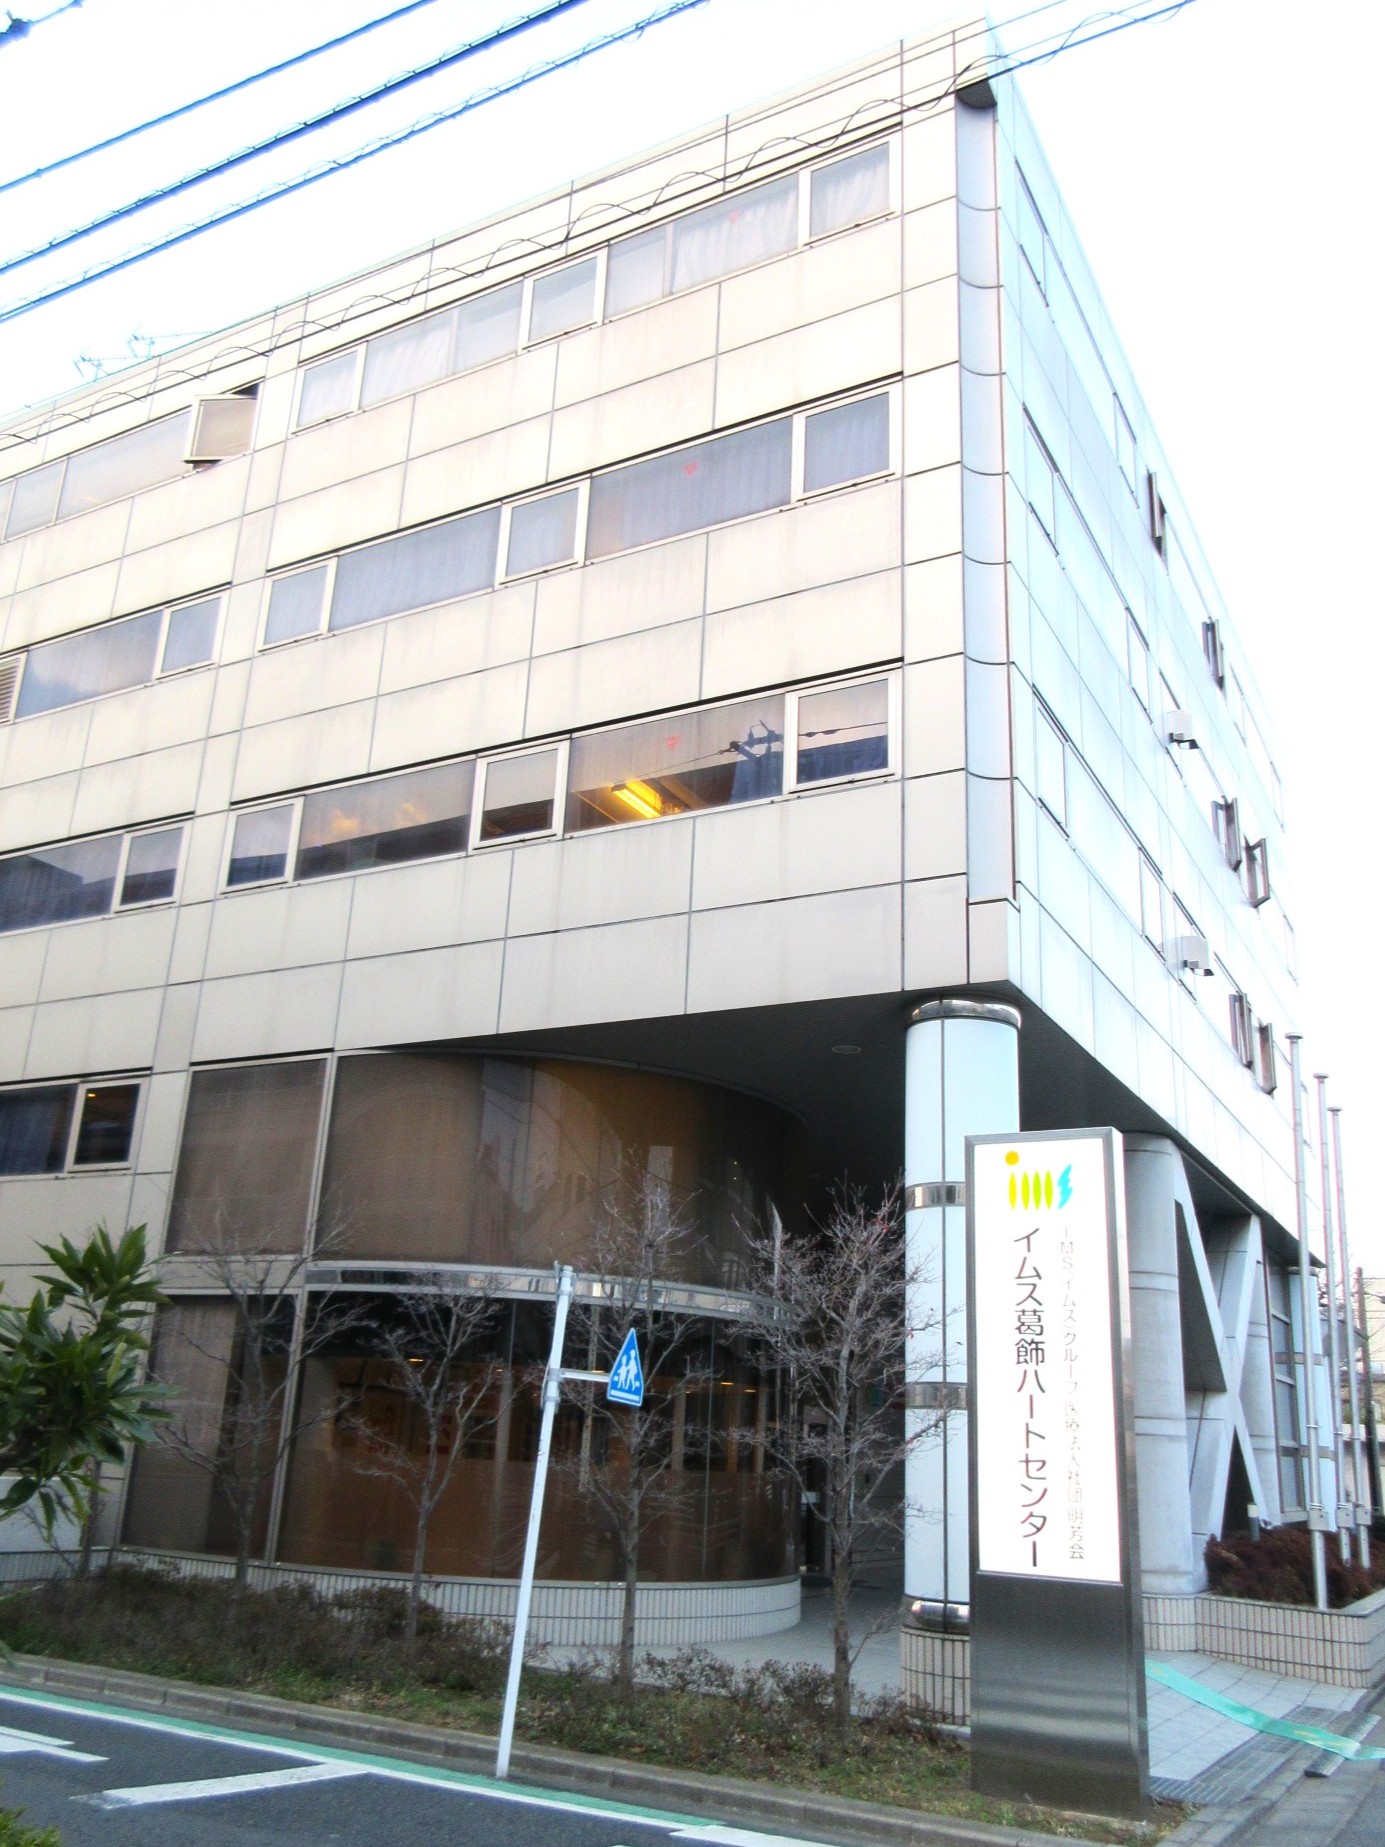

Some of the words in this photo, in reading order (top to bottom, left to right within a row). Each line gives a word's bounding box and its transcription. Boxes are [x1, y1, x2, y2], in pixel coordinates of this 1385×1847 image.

[1013, 1228, 1048, 1567] イムス葛飾ハートセンター
